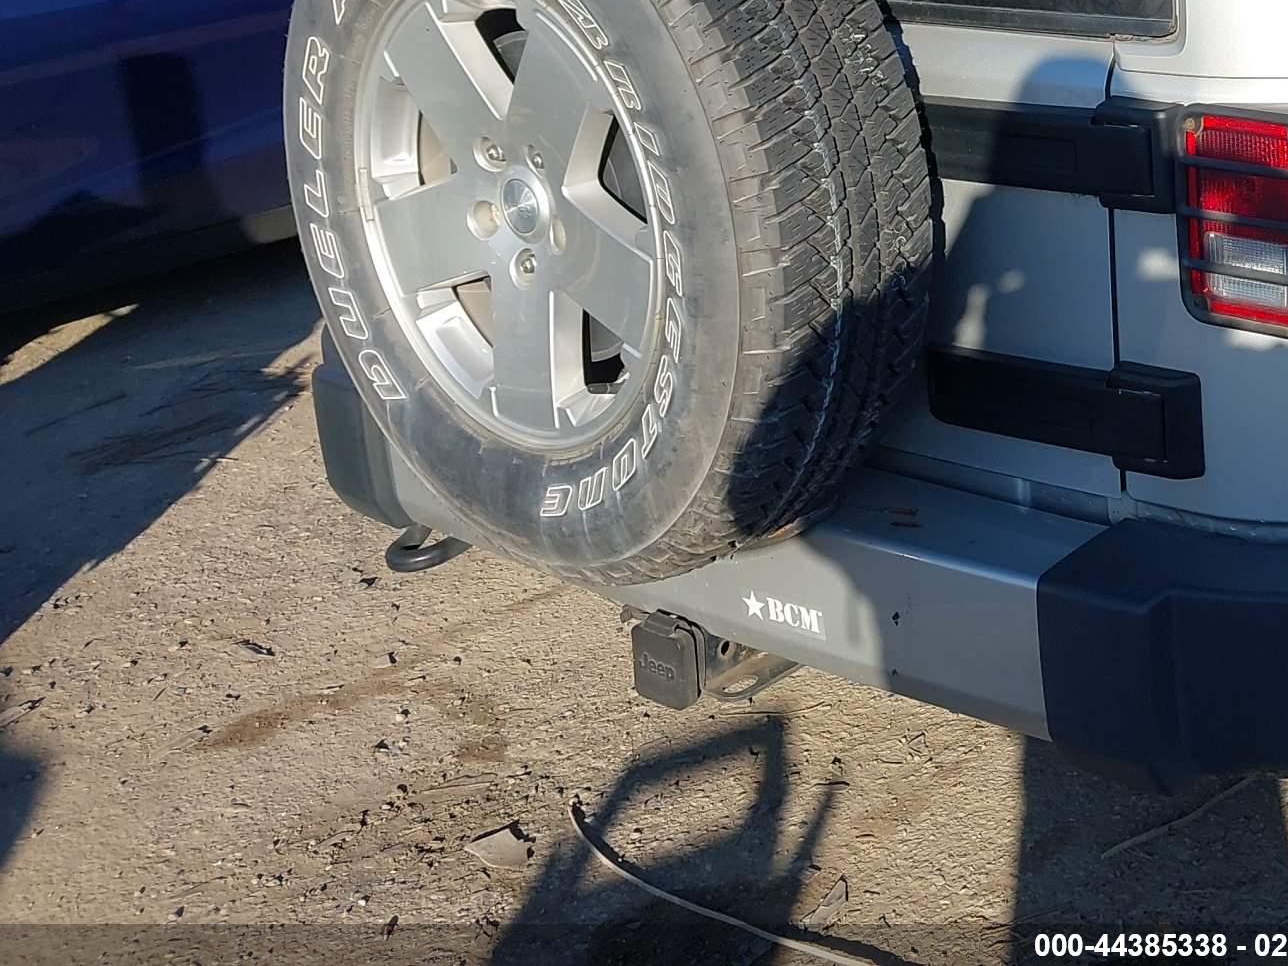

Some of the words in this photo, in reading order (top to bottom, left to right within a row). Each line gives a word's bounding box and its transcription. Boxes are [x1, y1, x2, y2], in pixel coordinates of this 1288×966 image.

[299, 36, 407, 400] DUELER
[766, 597, 822, 634] BCM
[638, 652, 677, 683] Jeep
